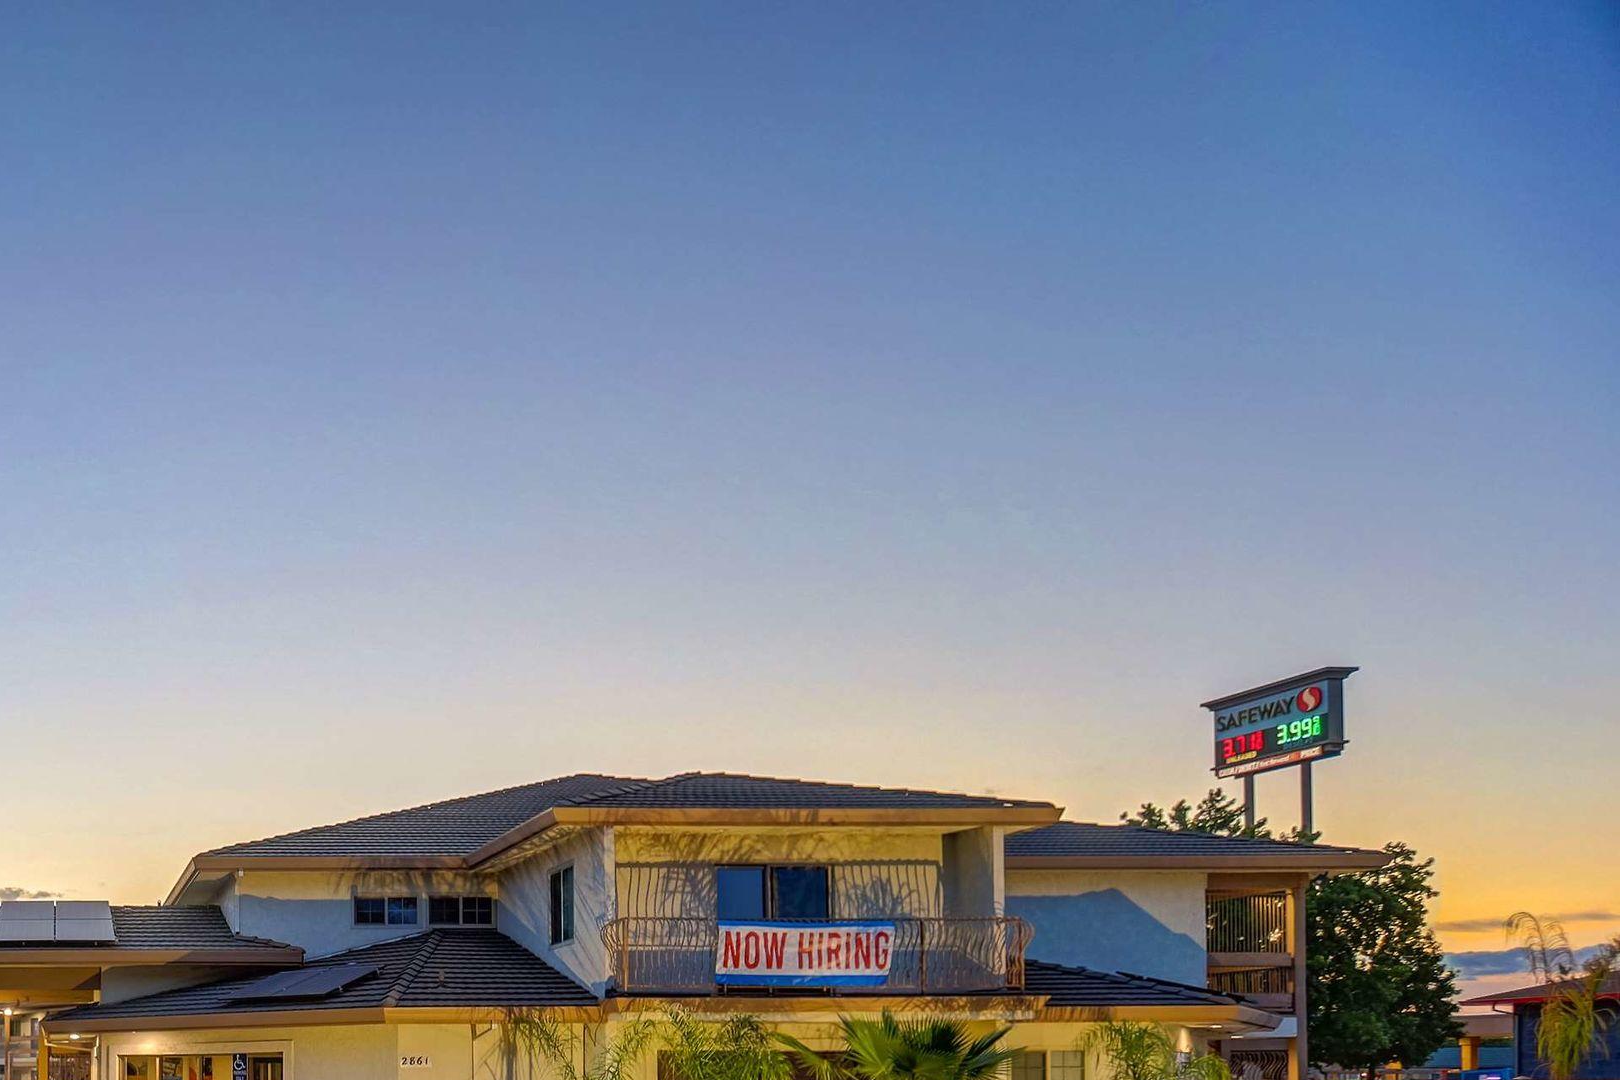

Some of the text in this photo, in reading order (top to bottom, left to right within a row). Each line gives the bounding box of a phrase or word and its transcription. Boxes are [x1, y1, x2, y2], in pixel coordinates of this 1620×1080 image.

[1217, 696, 1296, 732] SAFEWAY
[722, 930, 891, 970] NOW HIRING
[401, 1055, 428, 1066] 2861
